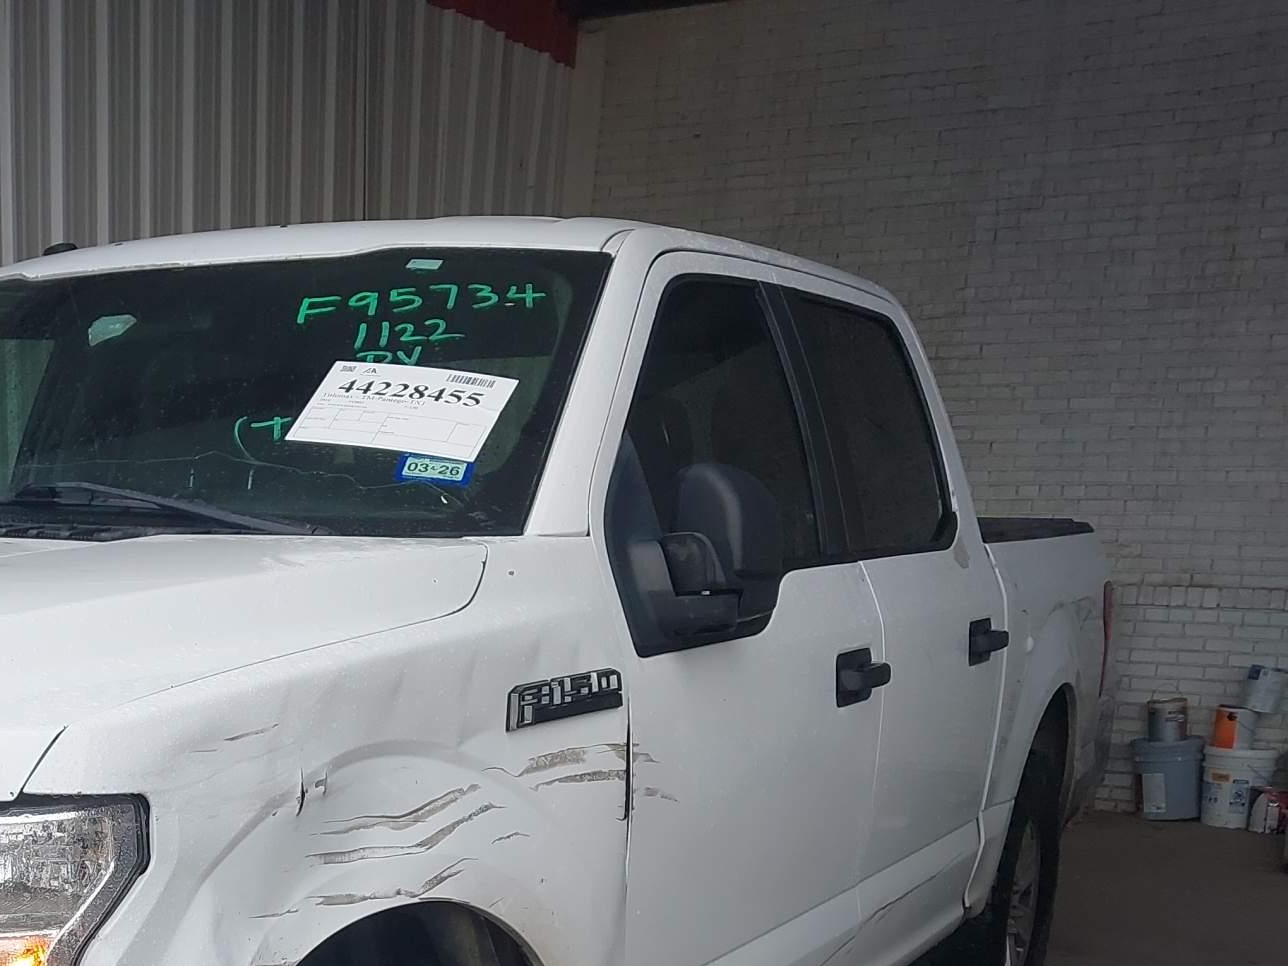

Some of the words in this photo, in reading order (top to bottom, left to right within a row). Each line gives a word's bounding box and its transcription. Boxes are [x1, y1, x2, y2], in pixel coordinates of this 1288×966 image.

[296, 284, 546, 324] F95734
[354, 319, 465, 349] 1122
[338, 379, 485, 407] 44228455
